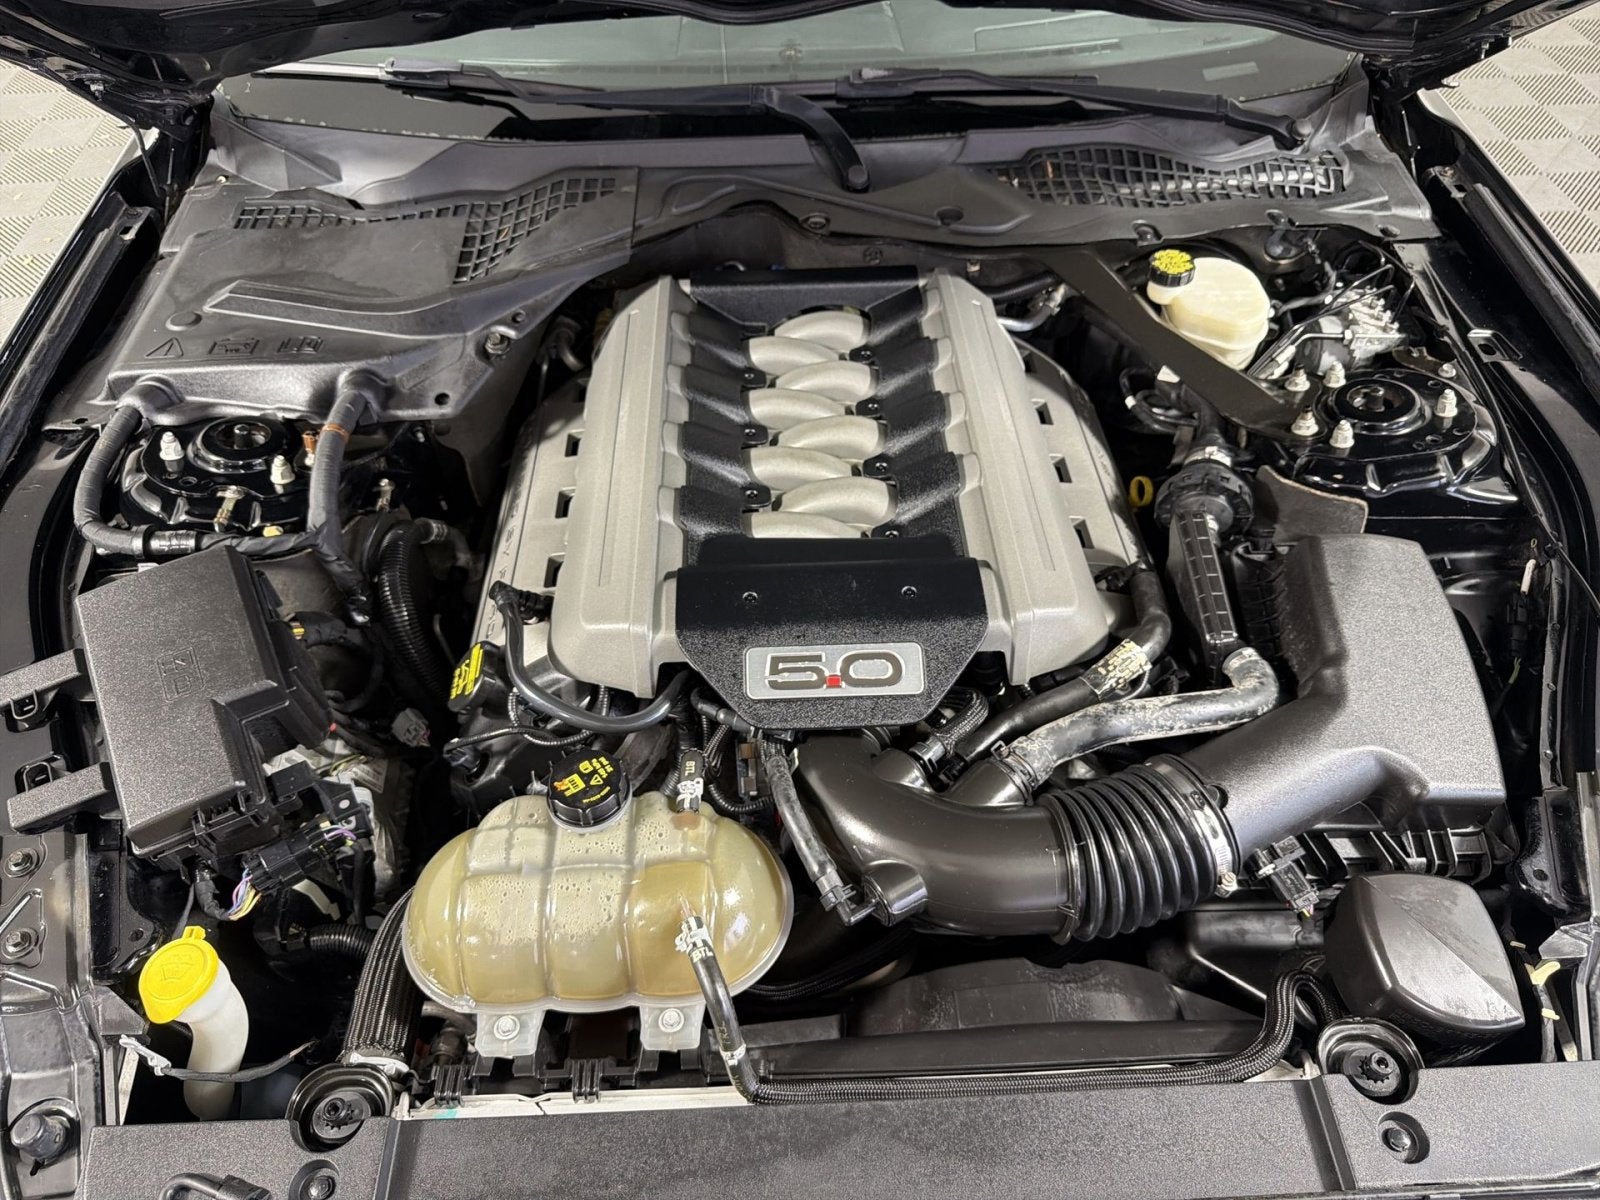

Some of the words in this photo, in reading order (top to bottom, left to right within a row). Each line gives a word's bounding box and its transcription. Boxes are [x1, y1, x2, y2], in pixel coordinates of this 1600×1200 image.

[765, 650, 905, 691] 5.0
[685, 761, 696, 776] BTL
[692, 947, 714, 963] BTL
